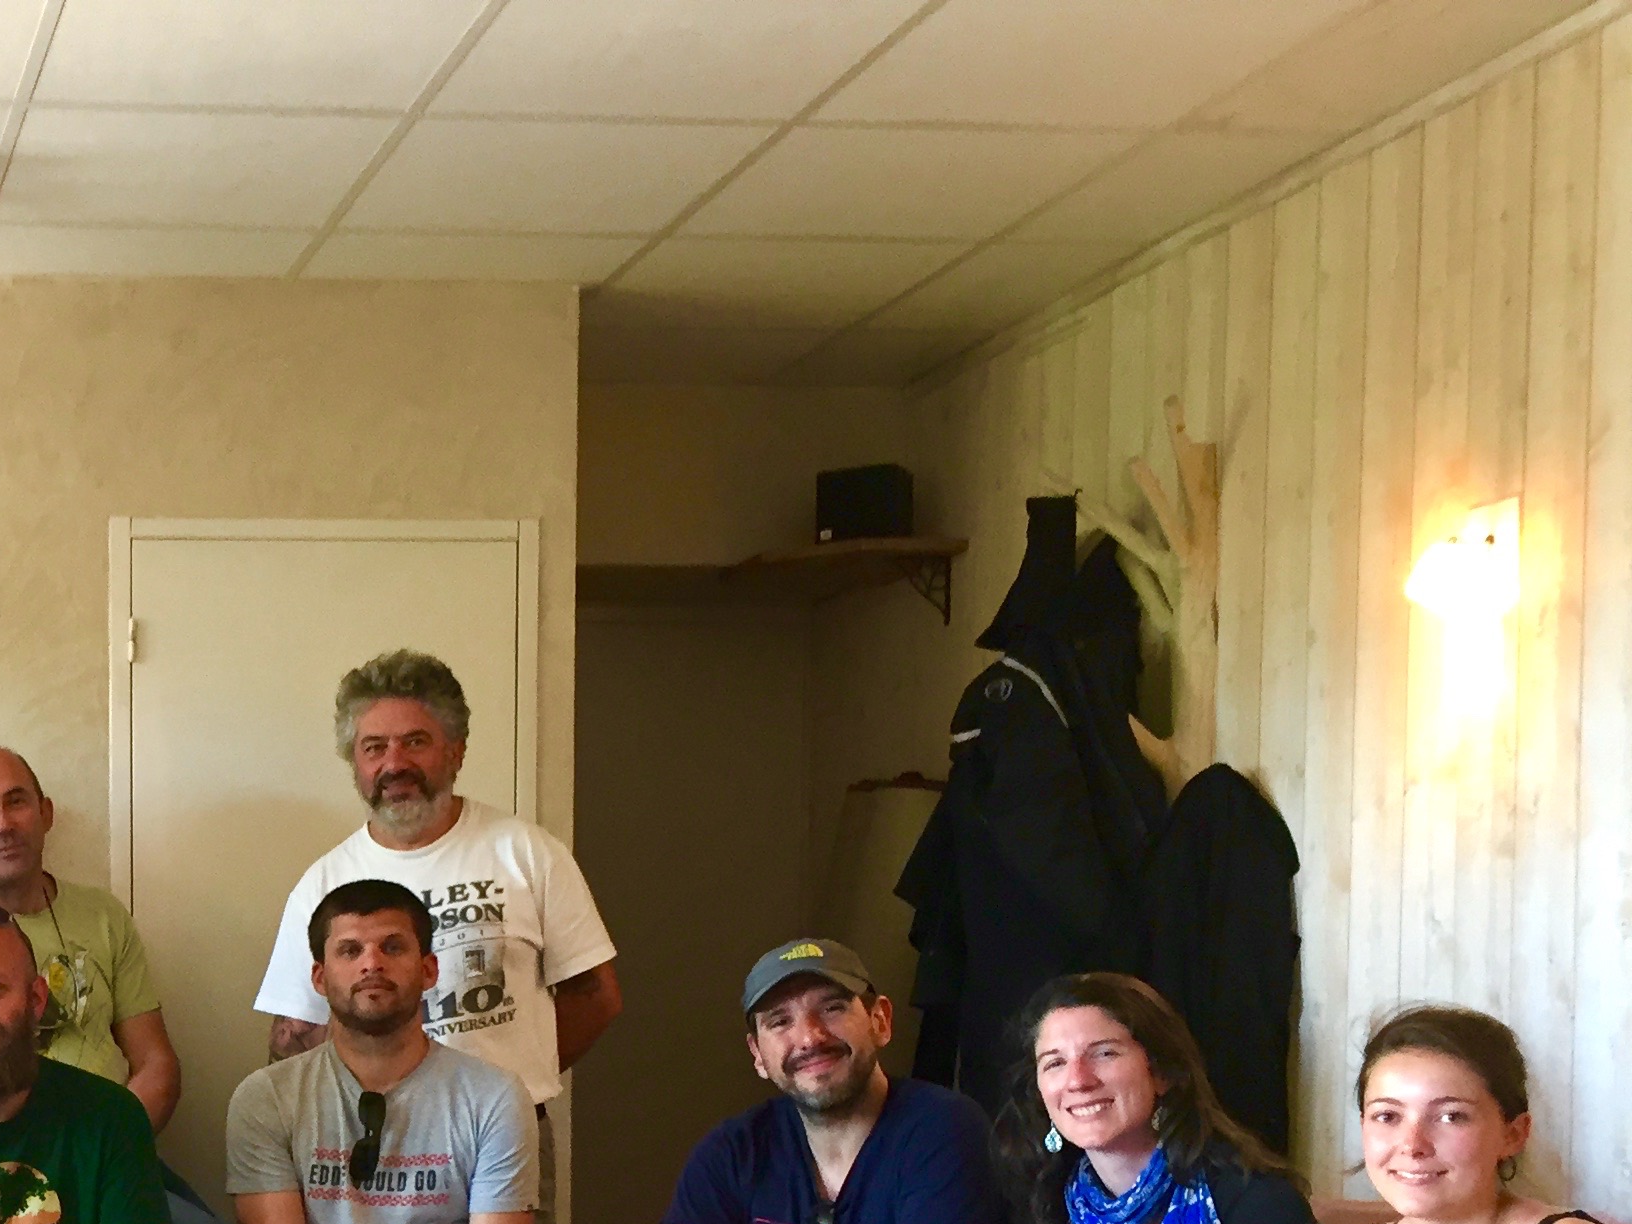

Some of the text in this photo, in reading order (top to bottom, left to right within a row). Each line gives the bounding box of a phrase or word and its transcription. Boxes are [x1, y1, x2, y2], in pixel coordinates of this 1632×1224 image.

[421, 880, 504, 909] LEY-
[426, 1008, 517, 1039] NIVERSARY
[363, 1171, 407, 1192] OULD
[414, 1169, 437, 1191] GO
